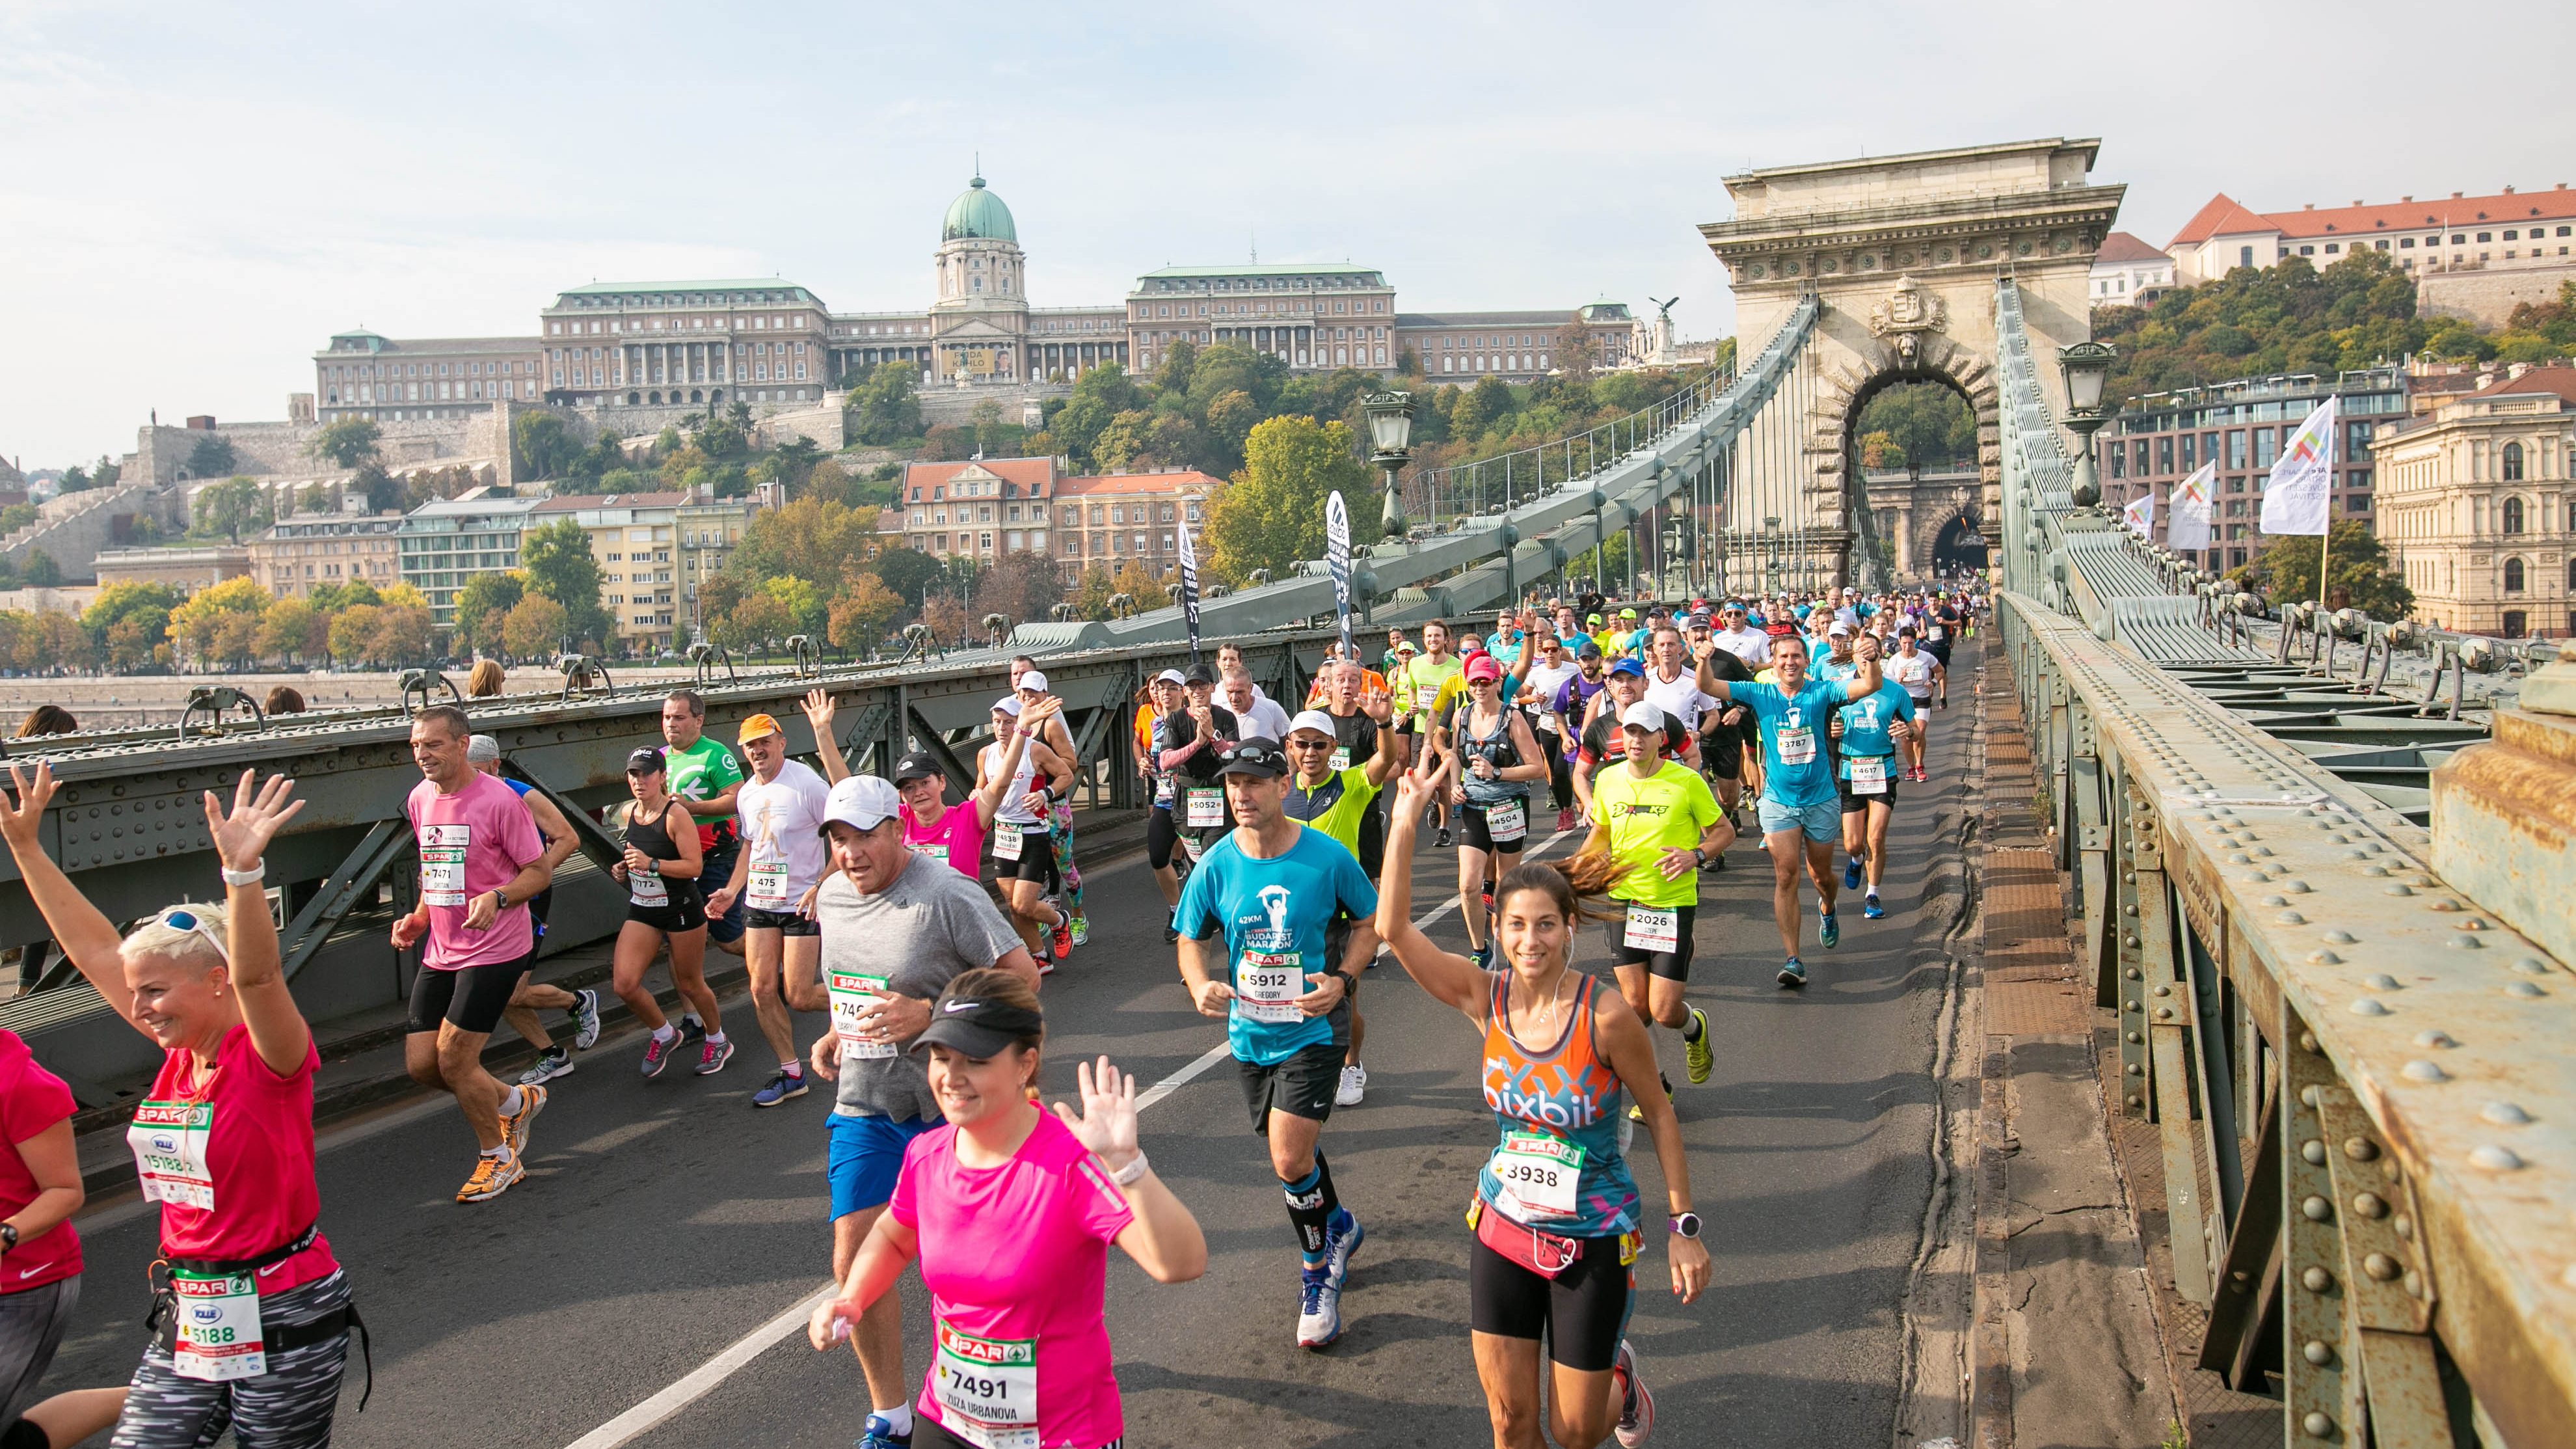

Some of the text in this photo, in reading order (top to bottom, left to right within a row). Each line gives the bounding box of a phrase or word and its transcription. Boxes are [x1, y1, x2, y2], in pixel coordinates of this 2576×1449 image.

[1785, 739, 1806, 748] 3787
[1494, 814, 1518, 825] 4504
[432, 869, 451, 878] 7471
[758, 878, 775, 887] 475
[1239, 915, 1262, 924] 42KM
[1637, 914, 1667, 926] 2026
[1245, 932, 1293, 941] BUDAPST
[1251, 953, 1283, 964] SPAR
[839, 978, 870, 990] SPAR
[1250, 974, 1287, 986] 5912
[1255, 990, 1281, 999] GREGORY
[1483, 1072, 1596, 1128] bixbit
[138, 1109, 182, 1121] SPAR
[1516, 1141, 1559, 1155] SPAR
[144, 1154, 183, 1172] 15188
[1507, 1163, 1557, 1187] 3938
[178, 1282, 226, 1294] SPAR
[193, 1327, 235, 1344] 5188
[948, 1333, 1002, 1360] SPAR
[952, 1369, 1008, 1400] 7491
[947, 1393, 967, 1412] ZUZA
[967, 1402, 1017, 1420] URBANOVA
